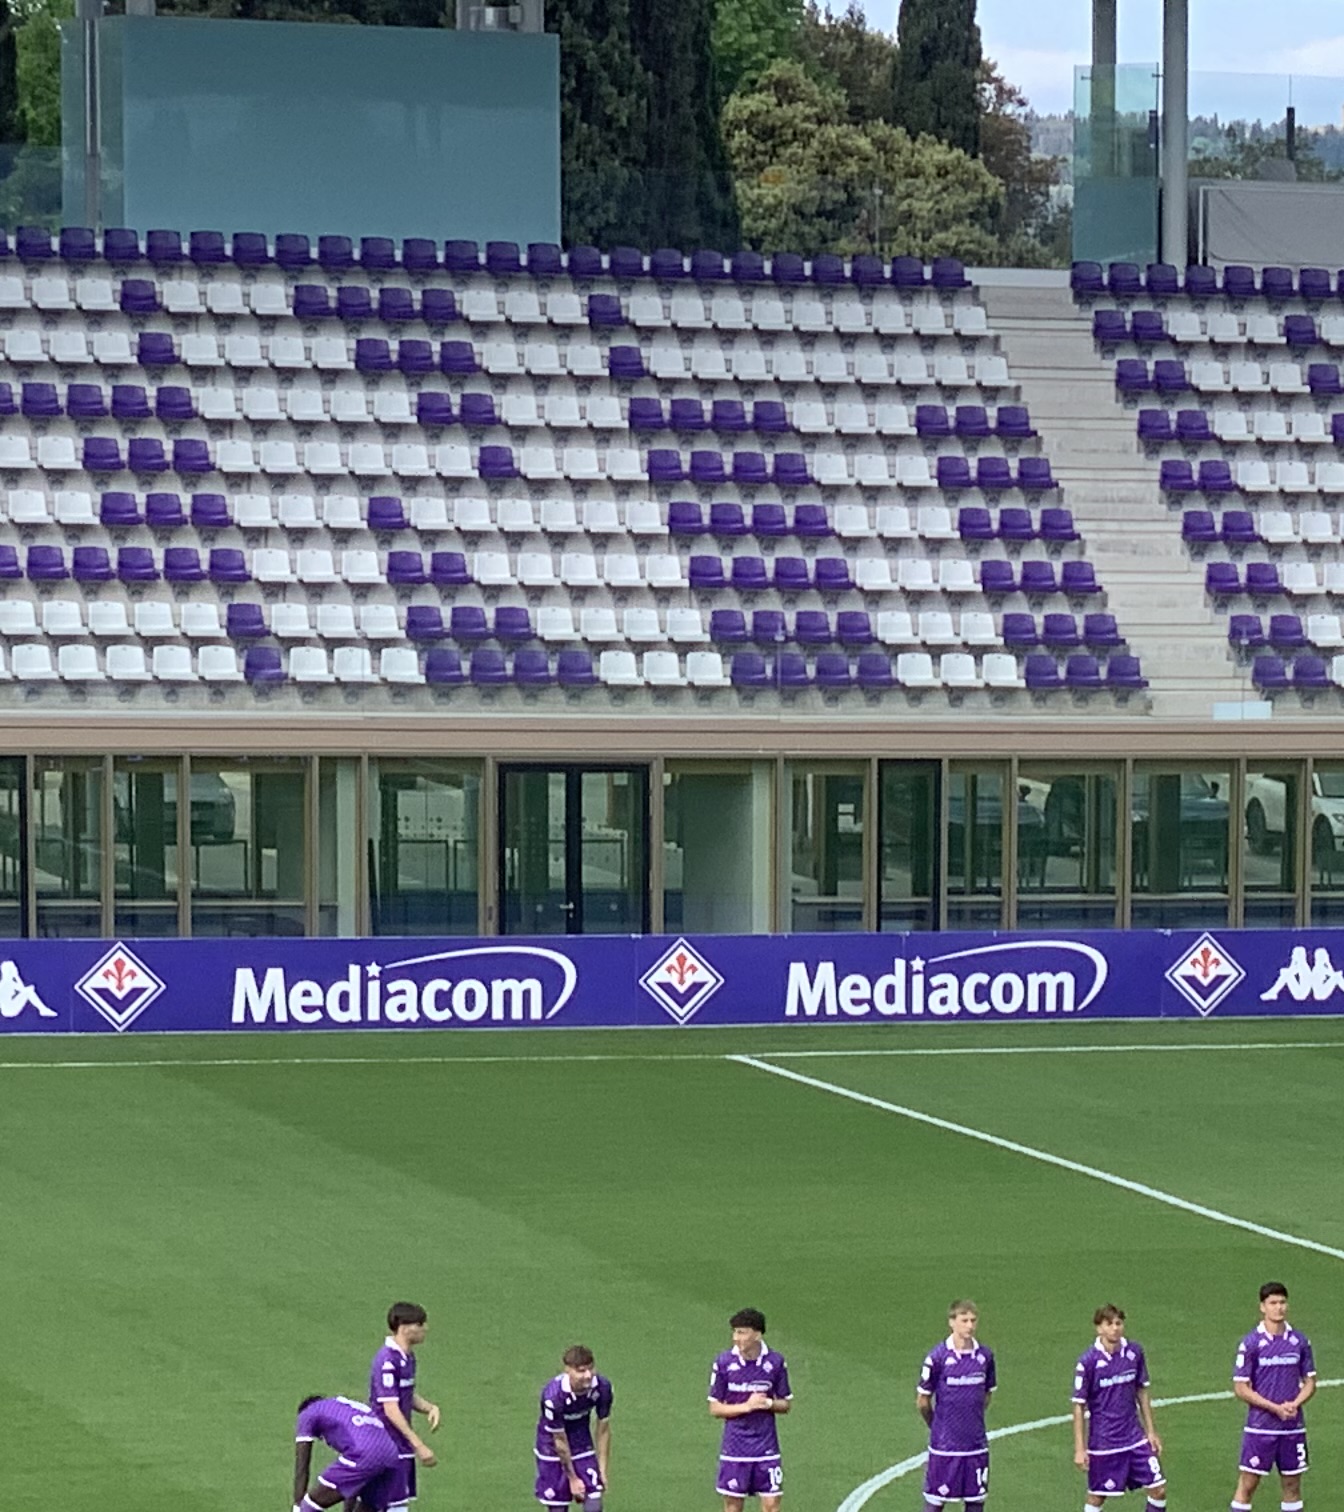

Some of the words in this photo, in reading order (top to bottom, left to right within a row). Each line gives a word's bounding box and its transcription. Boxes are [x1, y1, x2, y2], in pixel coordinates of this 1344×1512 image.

[231, 962, 542, 1023] Mediacom
[784, 956, 1076, 1017] Mediacom
[1296, 1443, 1306, 1461] 3
[1148, 1455, 1161, 1474] 8
[767, 1465, 783, 1487] 10
